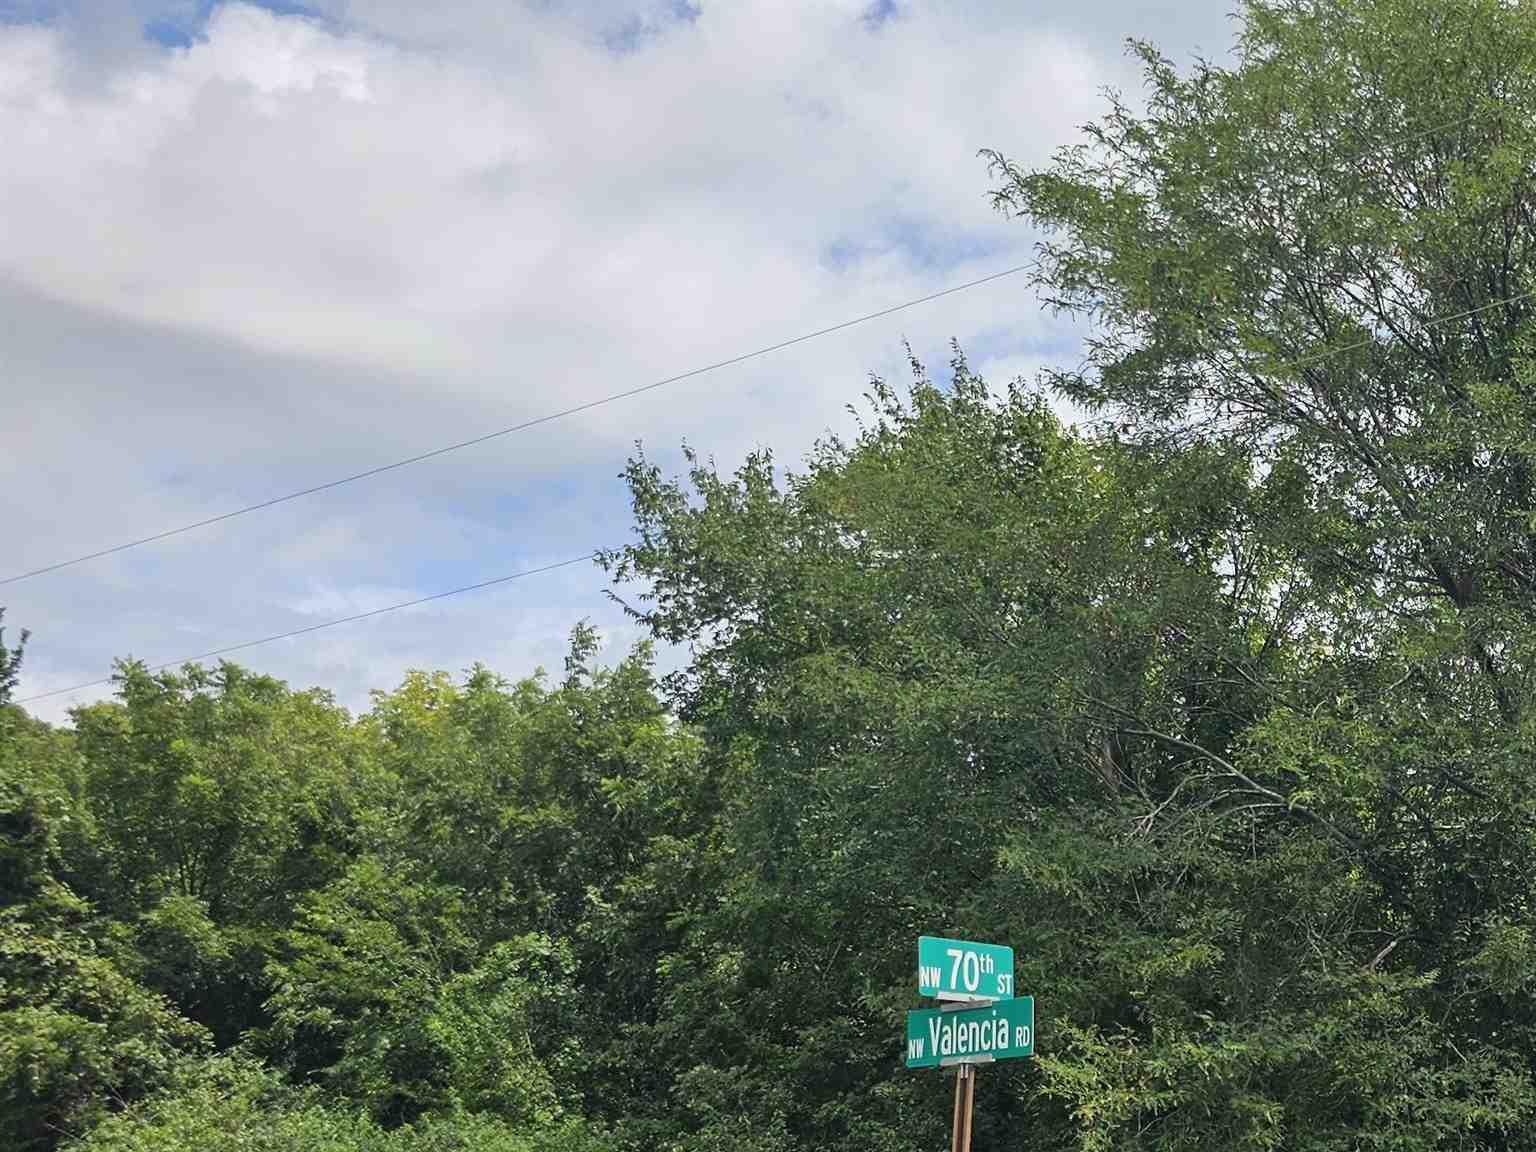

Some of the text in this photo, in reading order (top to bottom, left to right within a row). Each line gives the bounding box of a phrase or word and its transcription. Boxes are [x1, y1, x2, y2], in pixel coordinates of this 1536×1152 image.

[920, 949, 1013, 995] NW 70th ST
[908, 1010, 1030, 1059] NW Valencia RD
